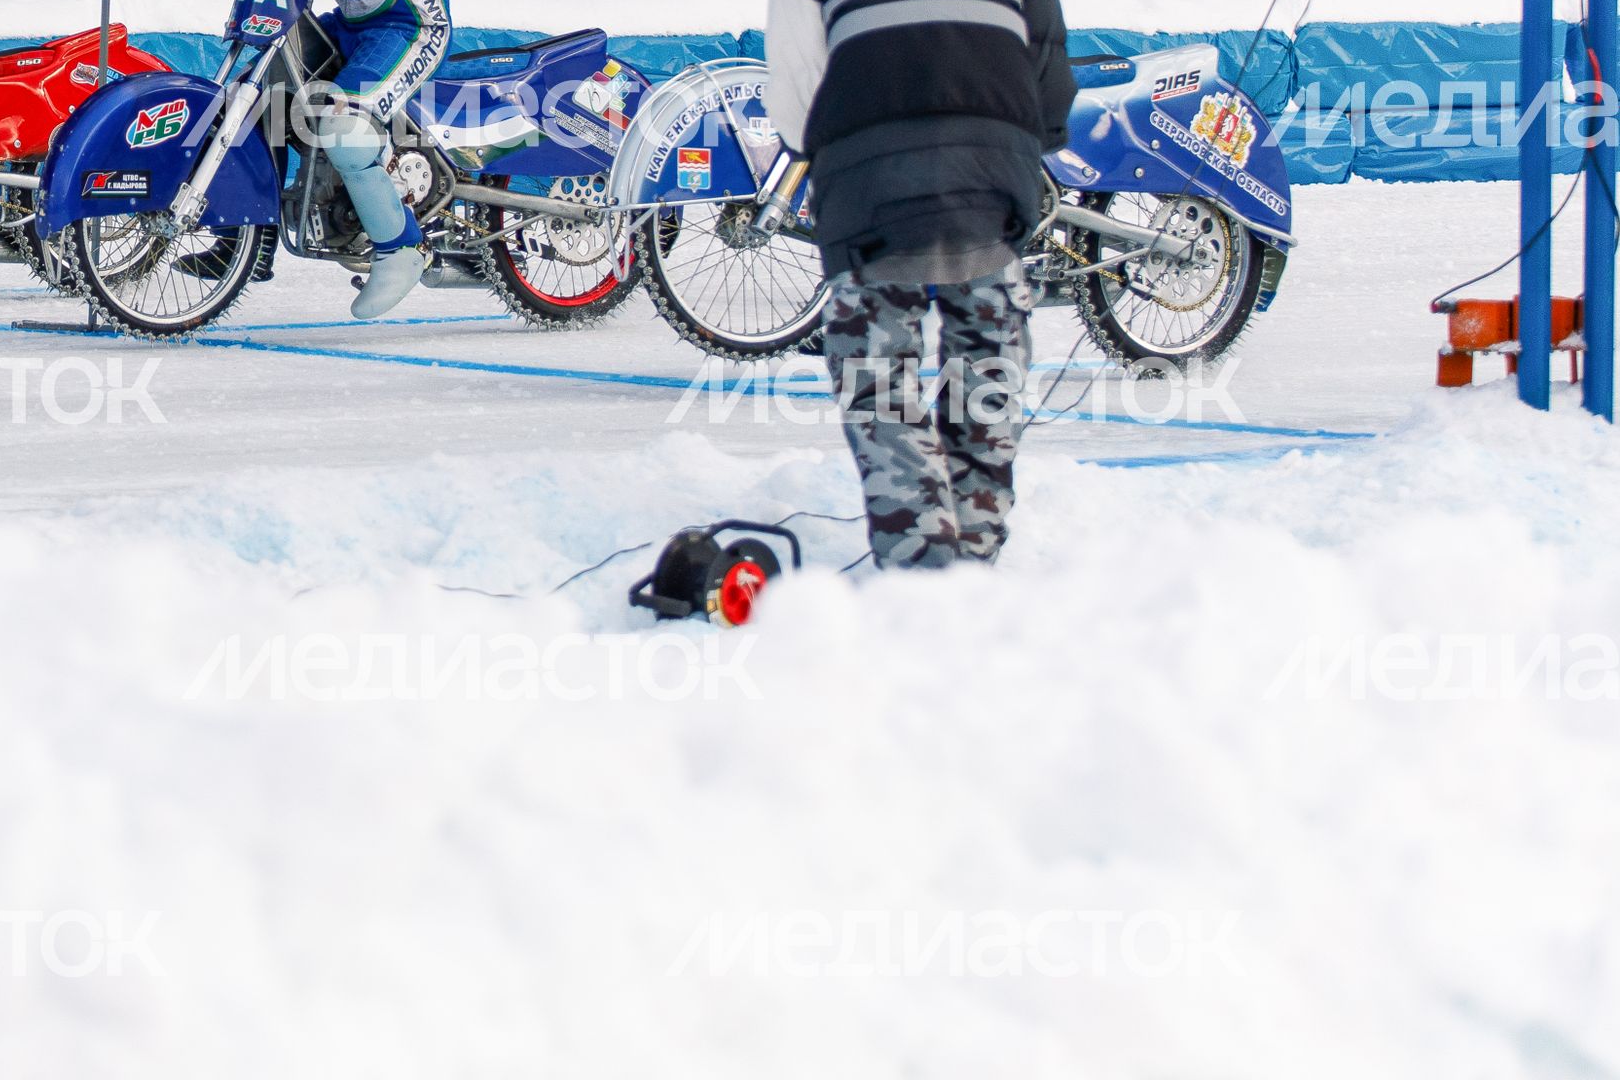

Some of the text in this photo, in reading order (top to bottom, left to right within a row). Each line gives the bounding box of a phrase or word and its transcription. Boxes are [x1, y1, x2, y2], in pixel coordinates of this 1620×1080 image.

[1153, 69, 1202, 93] DIAS
[1150, 111, 1286, 216] СВЕРДЛОВСКАЯ ОБЛАСТЬ
[112, 182, 148, 190] КАДЫРОВА
